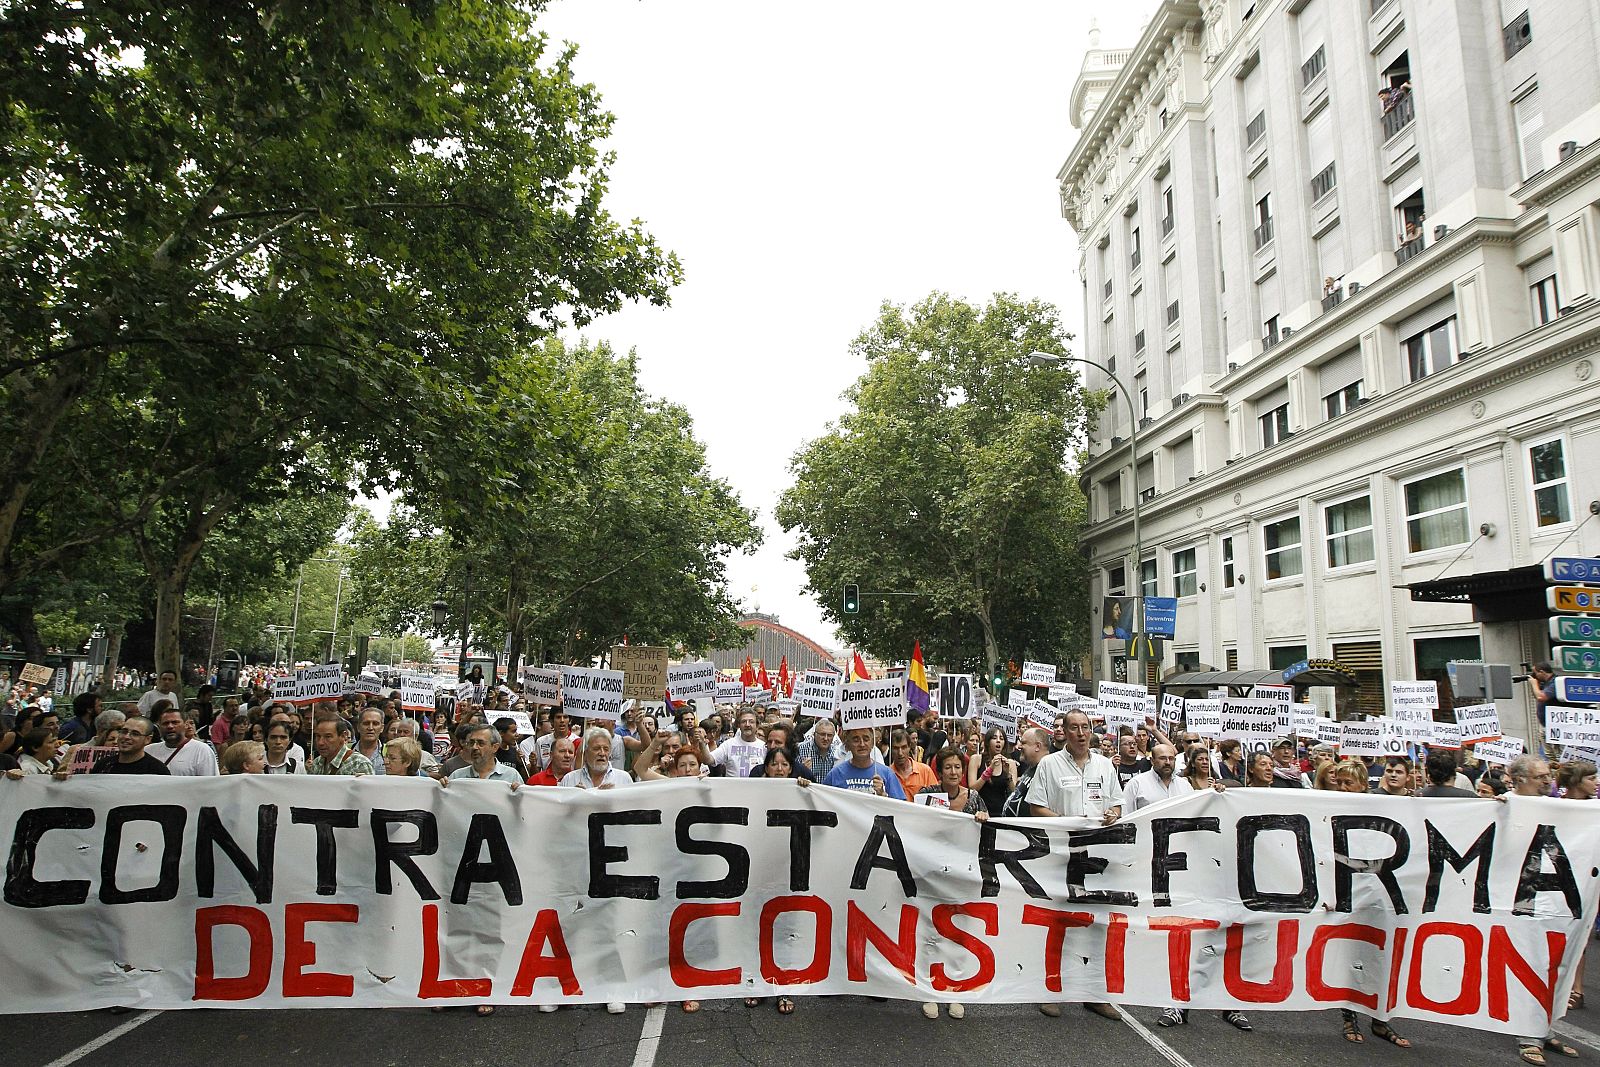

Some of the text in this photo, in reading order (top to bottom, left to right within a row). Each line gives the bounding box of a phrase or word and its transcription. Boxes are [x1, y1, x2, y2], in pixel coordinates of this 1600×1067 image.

[618, 649, 662, 660] PRESENTE
[616, 662, 626, 670] DE
[296, 670, 304, 681] Mi
[524, 670, 558, 686] Democracia
[624, 673, 656, 685] FUTURO
[669, 670, 692, 682] Reforma
[694, 666, 713, 678] asocial
[1030, 674, 1044, 682] VOTO
[1045, 675, 1054, 683] YO!
[402, 676, 407, 687] Mi
[563, 674, 571, 687] TU
[592, 677, 600, 690] MI
[704, 680, 715, 691] NO!
[806, 675, 836, 686] ROMPÉIS
[296, 682, 341, 697] LA VOTO YO!
[540, 689, 558, 700] estás?
[812, 688, 834, 698] PACTO
[842, 685, 900, 702] Democracia
[1100, 684, 1146, 698] Constitucionalizar
[1256, 689, 1289, 700] ROMPÉIS
[402, 692, 434, 705] LA VOTO YO!
[941, 676, 970, 717] NO
[591, 701, 596, 710] a
[802, 700, 832, 711] SOCIAL!
[1099, 698, 1103, 706] la
[1105, 699, 1131, 711] pobreza,
[1134, 702, 1146, 712] NO!
[1222, 702, 1276, 715] Democracia
[844, 704, 902, 723] ¿dónde estás?
[1162, 709, 1180, 721] NO!
[982, 718, 986, 727] la
[1006, 725, 1016, 735] NO!
[1187, 717, 1193, 725] la
[1222, 719, 1277, 733] ¿dónde estás?
[1343, 726, 1379, 736] Democracia
[1460, 721, 1499, 736] LA VOTO YO!
[1551, 728, 1560, 738] NO
[1342, 740, 1379, 750] ¿dónde estás?
[4, 804, 1582, 919] CONTRA ESTA REFORMA
[192, 895, 1566, 1024] DE LA CONSTITUCION
